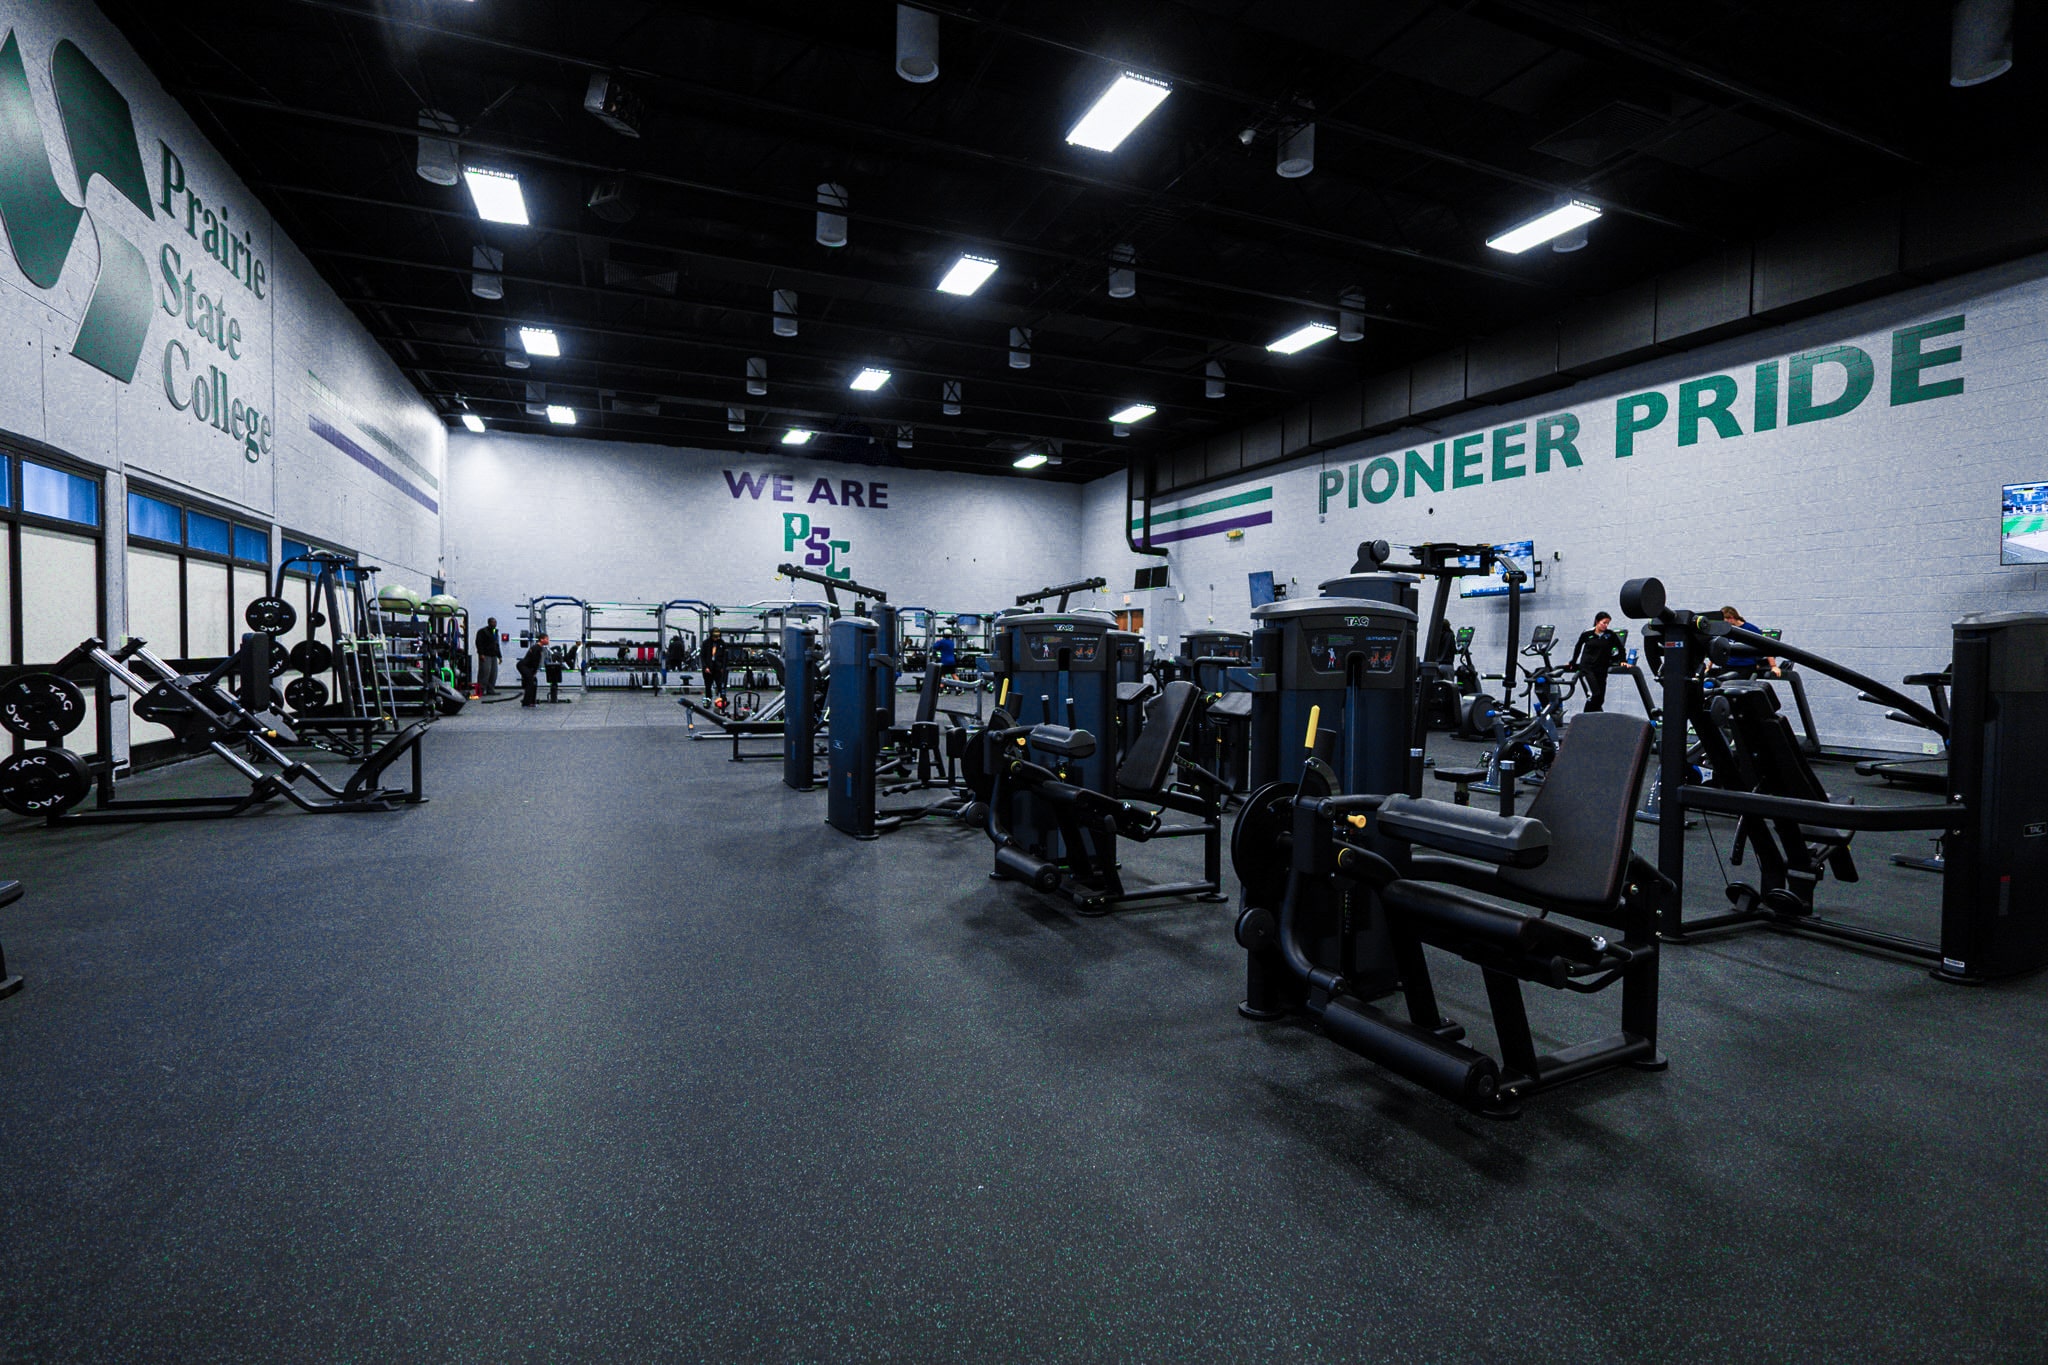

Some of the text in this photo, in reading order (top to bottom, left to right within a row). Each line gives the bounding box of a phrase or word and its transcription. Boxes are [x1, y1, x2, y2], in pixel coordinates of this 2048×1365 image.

[158, 138, 266, 300] Prairie
[160, 243, 242, 361] State
[162, 339, 272, 463] College
[1319, 314, 1966, 514] PIONEER PRIDE
[722, 470, 889, 509] WE ARE
[782, 512, 851, 580] PSC
[258, 600, 281, 609] TAG
[1344, 616, 1370, 627] TAG
[49, 684, 73, 711] TAG
[5, 703, 31, 731] TAG
[8, 756, 47, 771] TAG
[27, 794, 65, 809] TAG
